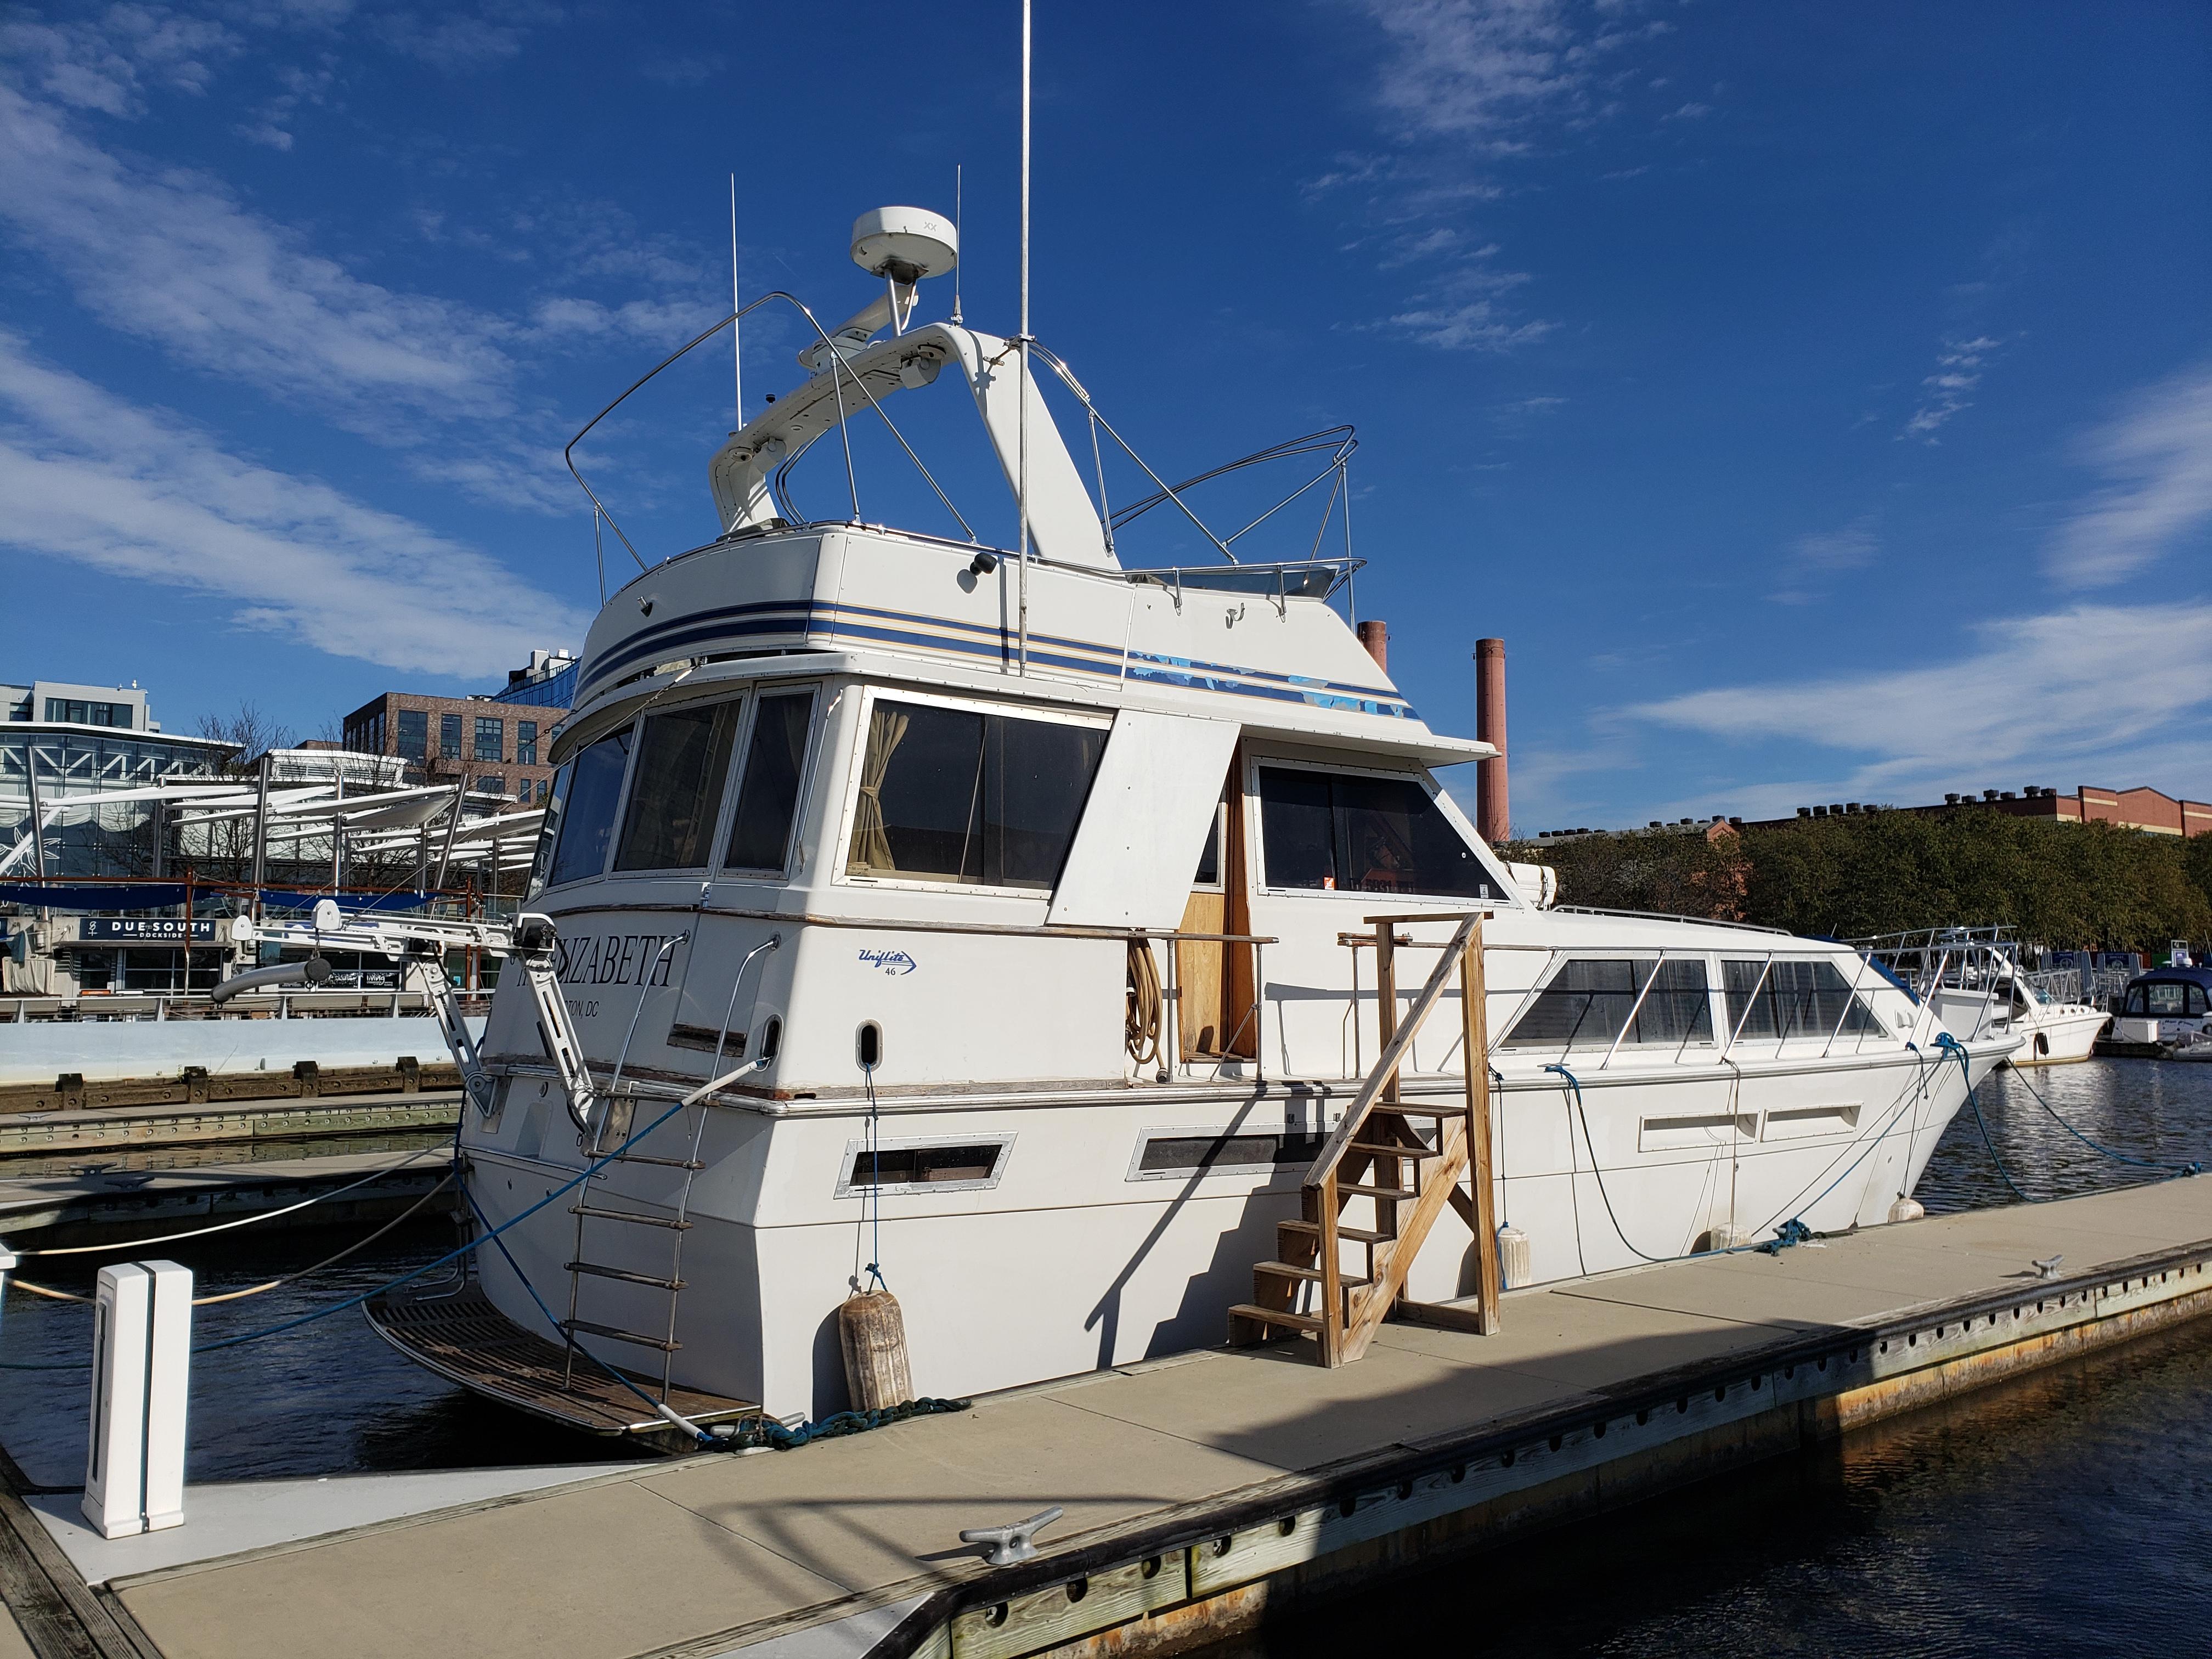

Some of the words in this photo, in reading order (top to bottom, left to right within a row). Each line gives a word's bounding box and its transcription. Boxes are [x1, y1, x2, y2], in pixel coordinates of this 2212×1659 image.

[112, 922, 145, 931] DUE
[153, 922, 210, 932] SOUTH
[859, 950, 905, 967] Uniflite
[885, 967, 896, 975] 46
[585, 1001, 599, 1017] DC
